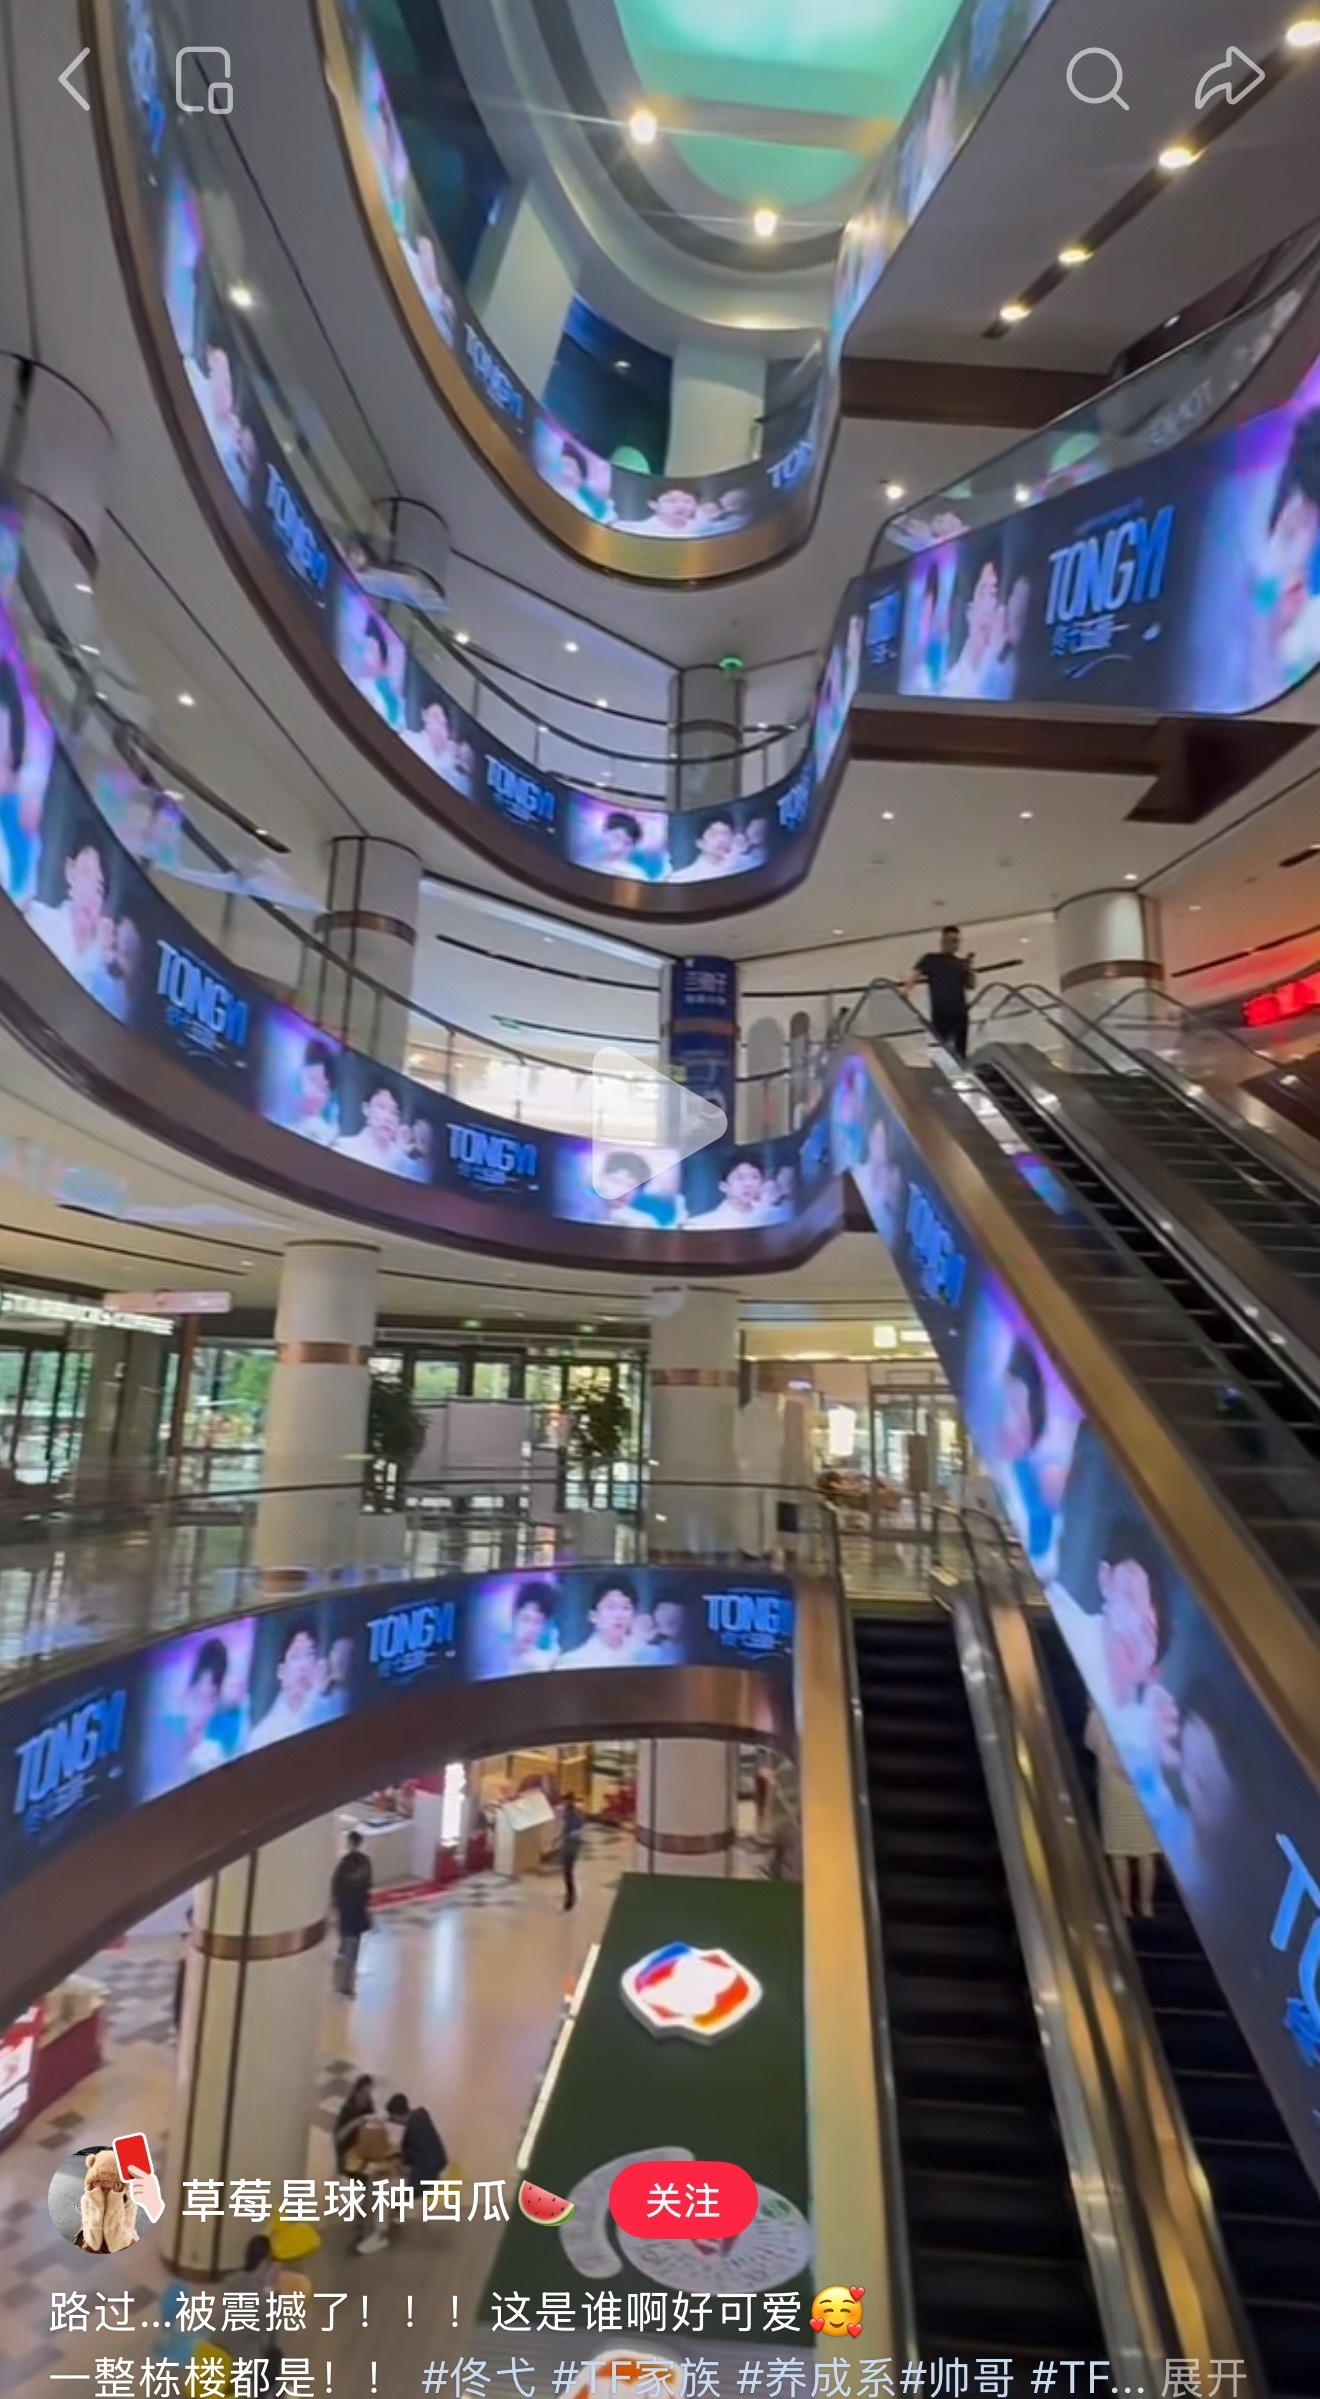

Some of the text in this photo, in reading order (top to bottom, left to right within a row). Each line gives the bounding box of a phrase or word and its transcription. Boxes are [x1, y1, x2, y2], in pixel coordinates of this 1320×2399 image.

[1046, 505, 1174, 626] TONGYI
[485, 754, 556, 820] TONGYI
[157, 940, 248, 1046] TONGYI
[446, 1123, 537, 1177] TONGYI
[366, 1602, 455, 1662] TONGYI
[14, 1690, 126, 1814] TONGYI
